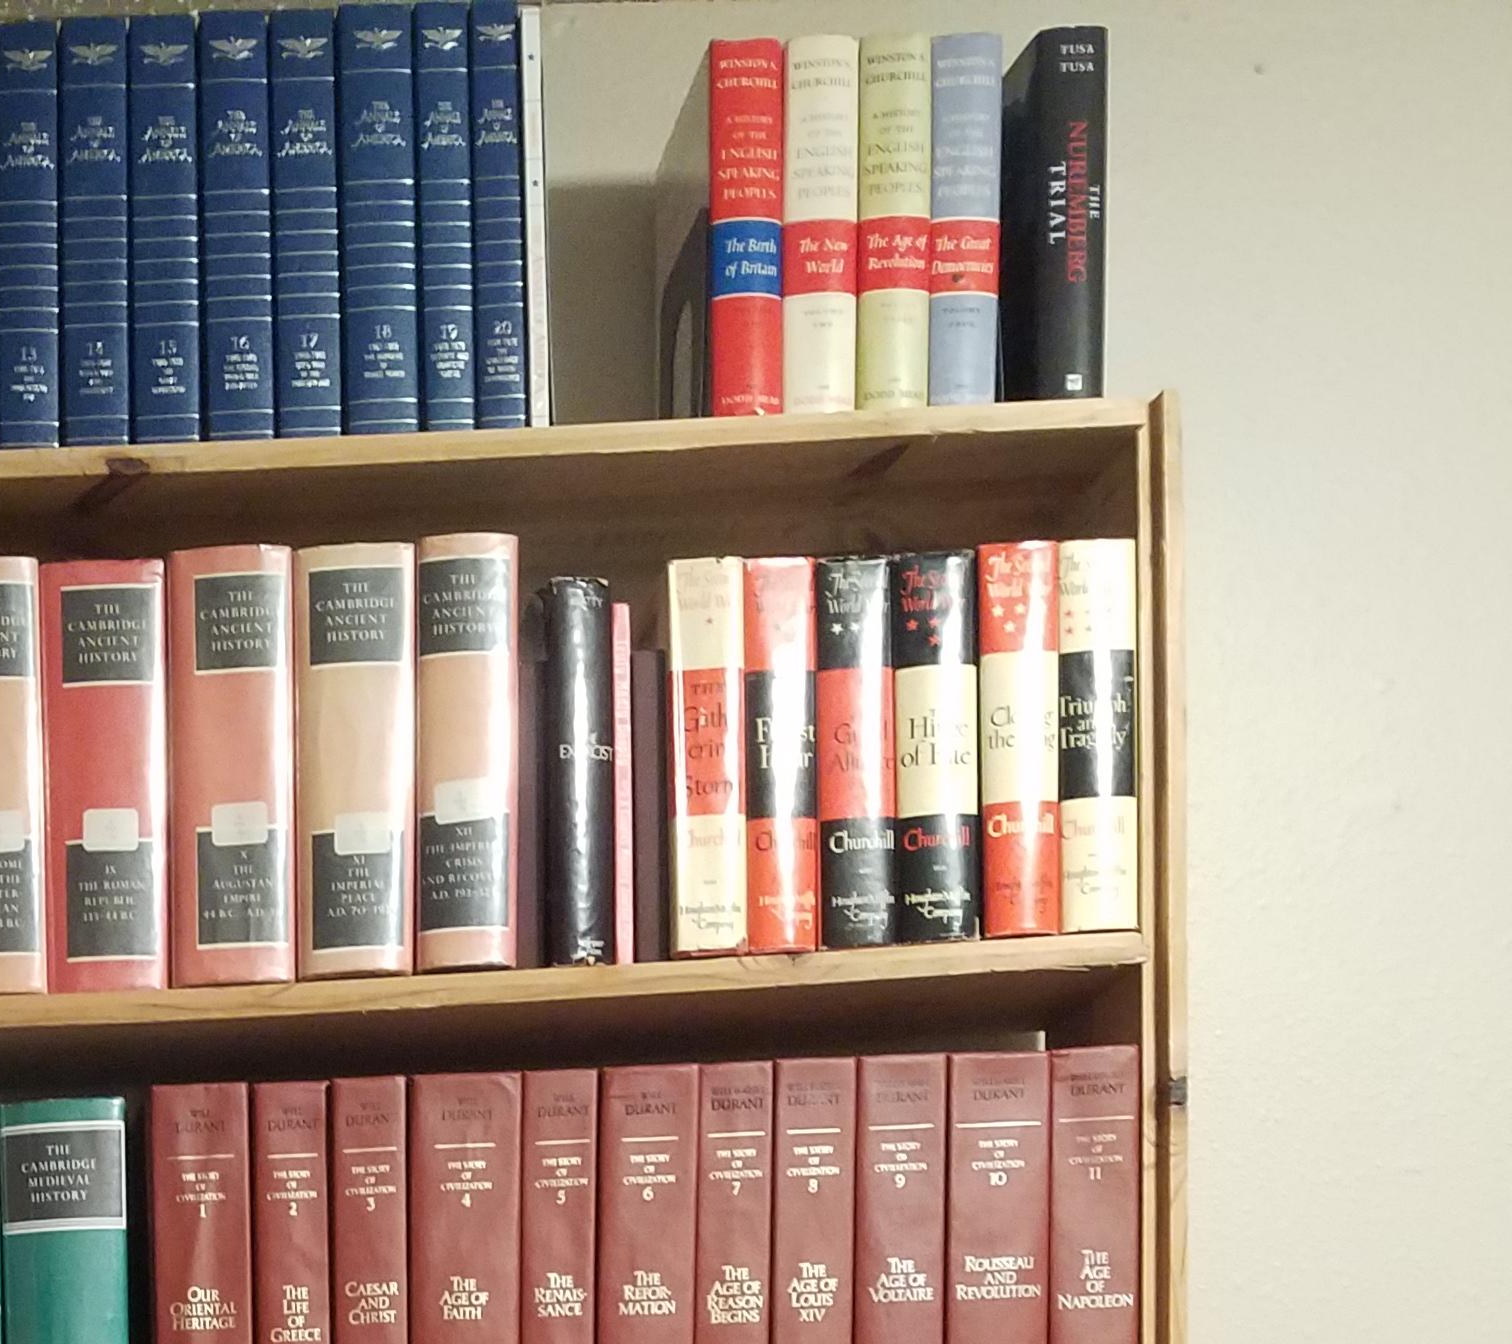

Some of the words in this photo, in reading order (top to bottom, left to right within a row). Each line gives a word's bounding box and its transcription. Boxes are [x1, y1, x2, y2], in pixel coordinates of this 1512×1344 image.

[1047, 161, 1066, 244] TRIAL
[725, 238, 744, 252] The
[800, 238, 820, 252] The
[867, 234, 888, 249] The
[896, 1173, 906, 1189] 9
[990, 1171, 1007, 1186] 10
